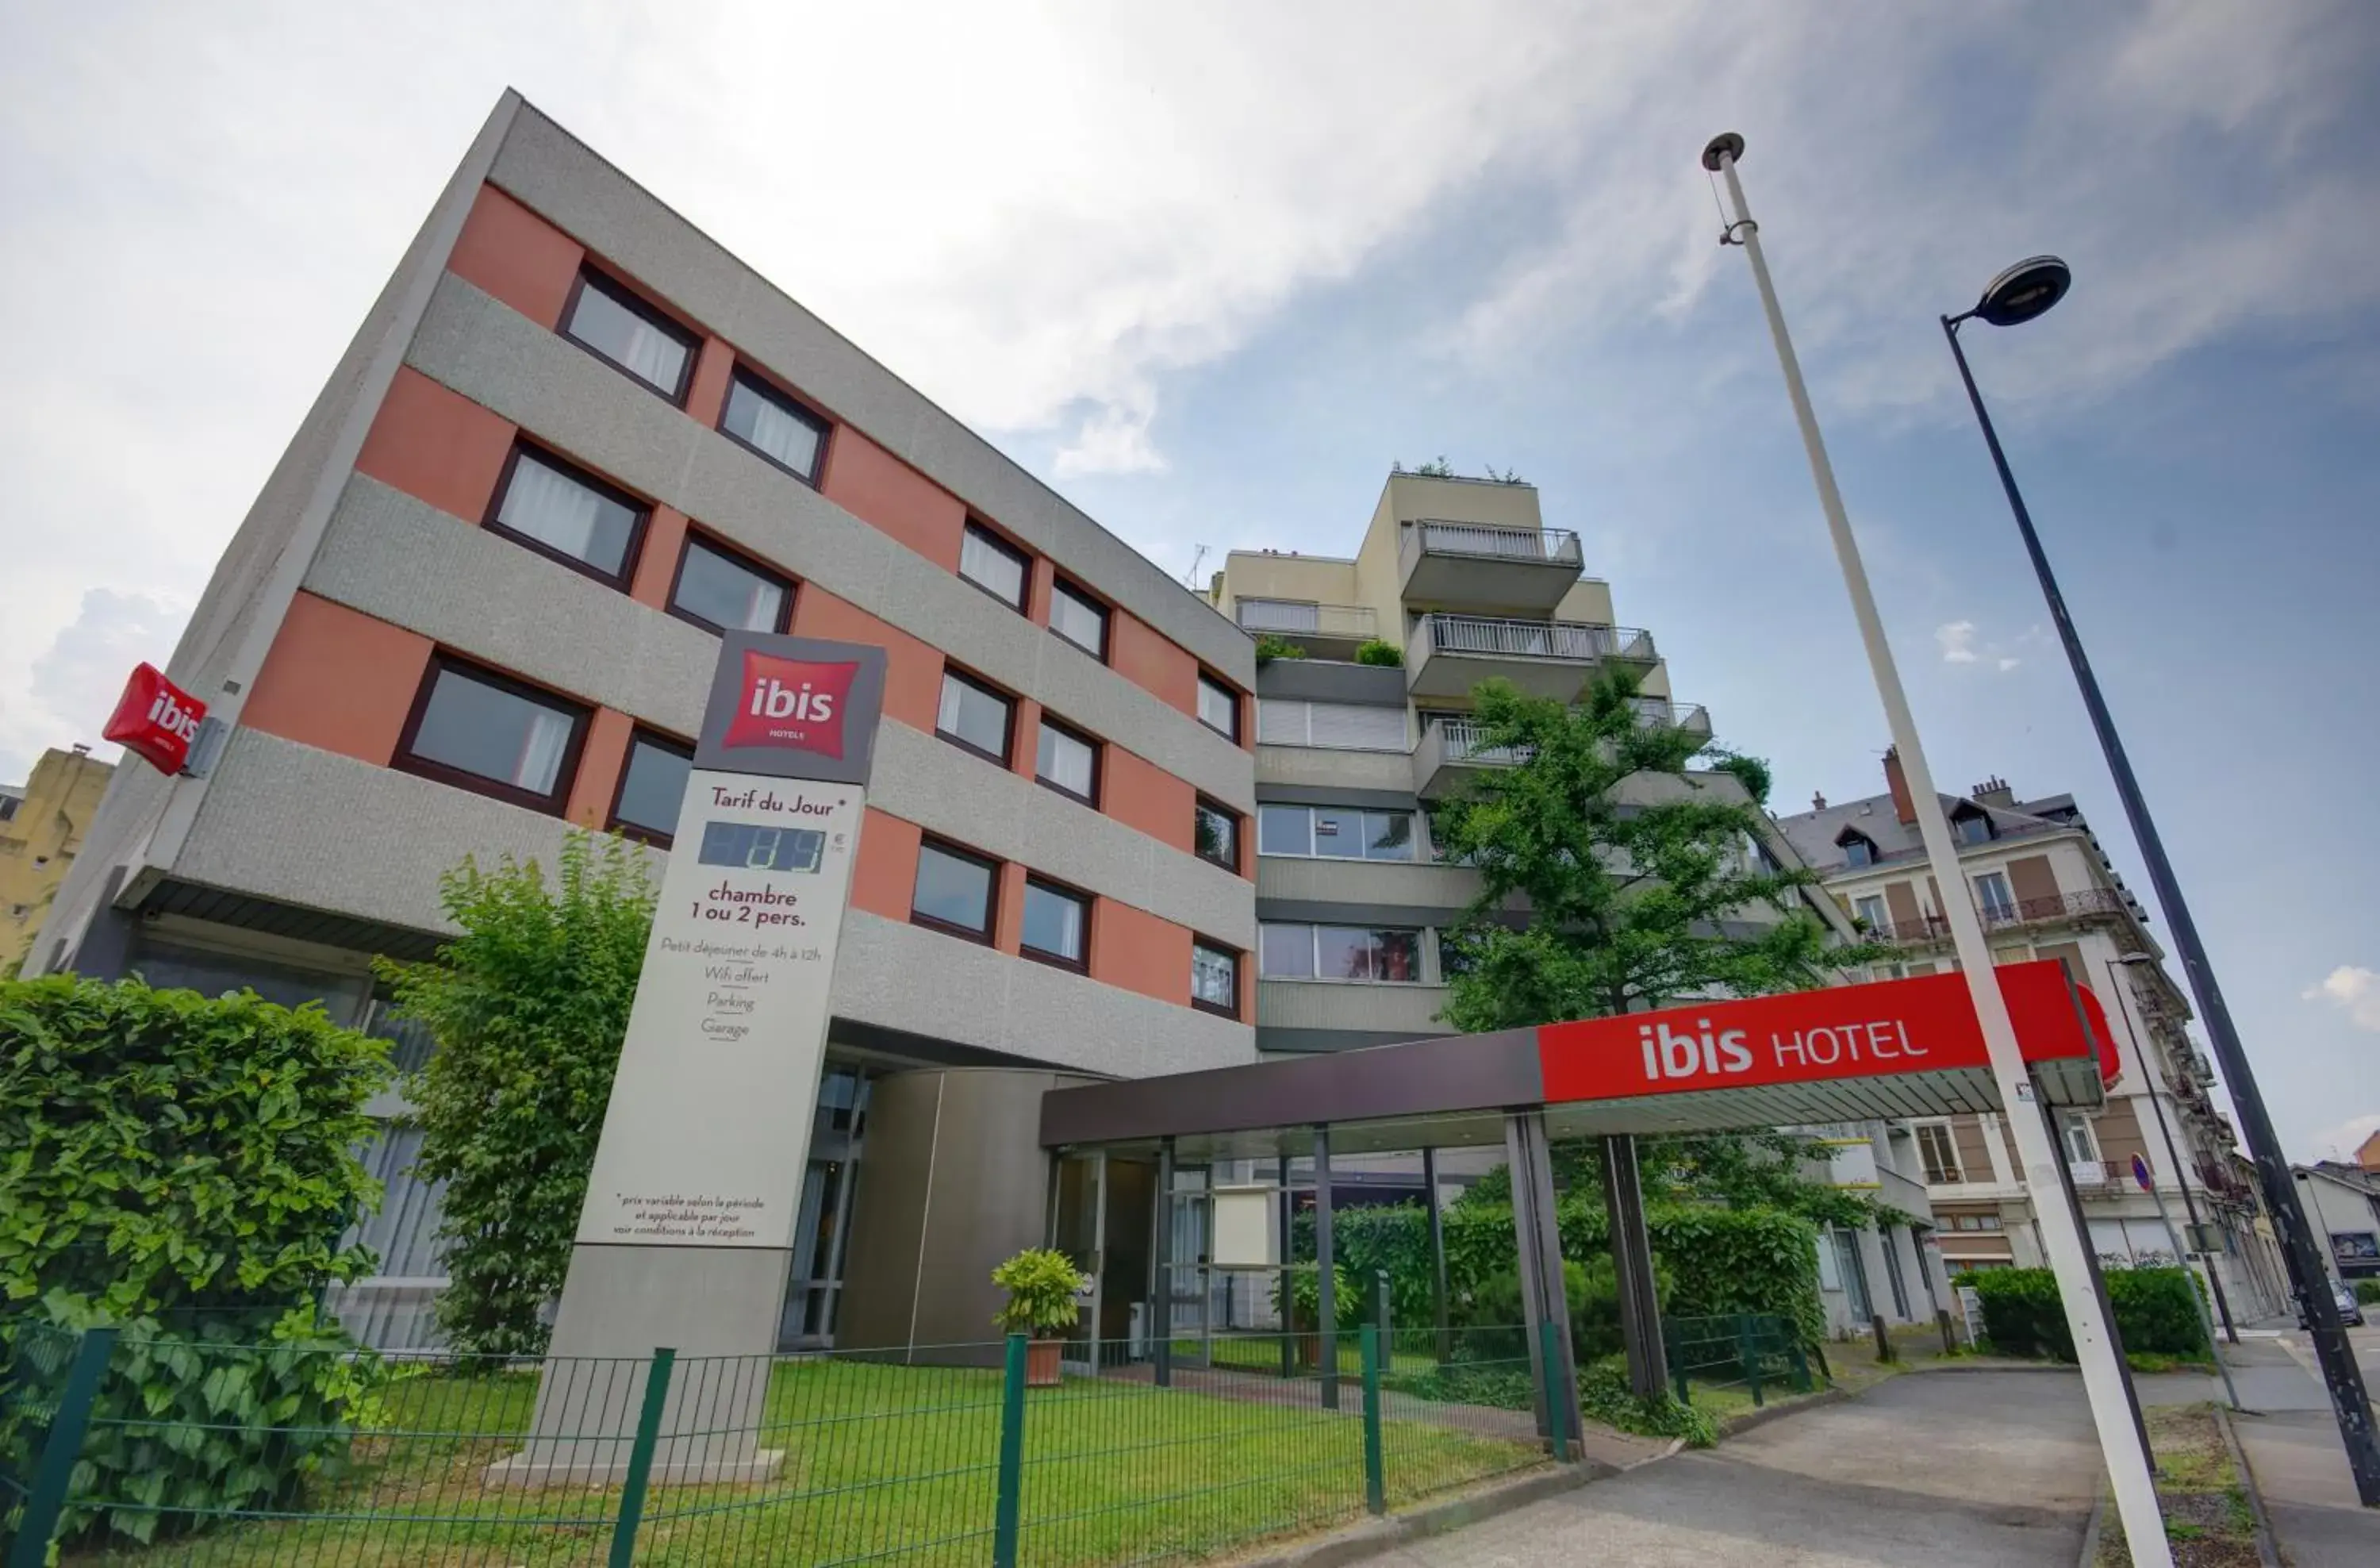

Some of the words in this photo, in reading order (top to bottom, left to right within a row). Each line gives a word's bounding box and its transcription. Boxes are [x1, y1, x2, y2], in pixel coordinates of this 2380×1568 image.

[750, 678, 833, 722] ibis
[147, 690, 200, 744] ibis
[712, 786, 758, 809] Tarif
[759, 791, 783, 812] du
[789, 794, 834, 816] Jour
[708, 879, 797, 906] chambre
[692, 901, 700, 919] 1
[705, 908, 731, 921] ou
[736, 905, 751, 923] 2
[754, 912, 806, 930] pers.
[661, 936, 690, 953] Petit
[751, 943, 767, 958] de
[705, 966, 732, 982] Wifi
[735, 968, 770, 983] offert
[707, 991, 755, 1013] Parking
[701, 1017, 750, 1038] Garage
[1638, 1019, 1753, 1080] ibis
[1772, 1020, 1929, 1067] HOTEL
